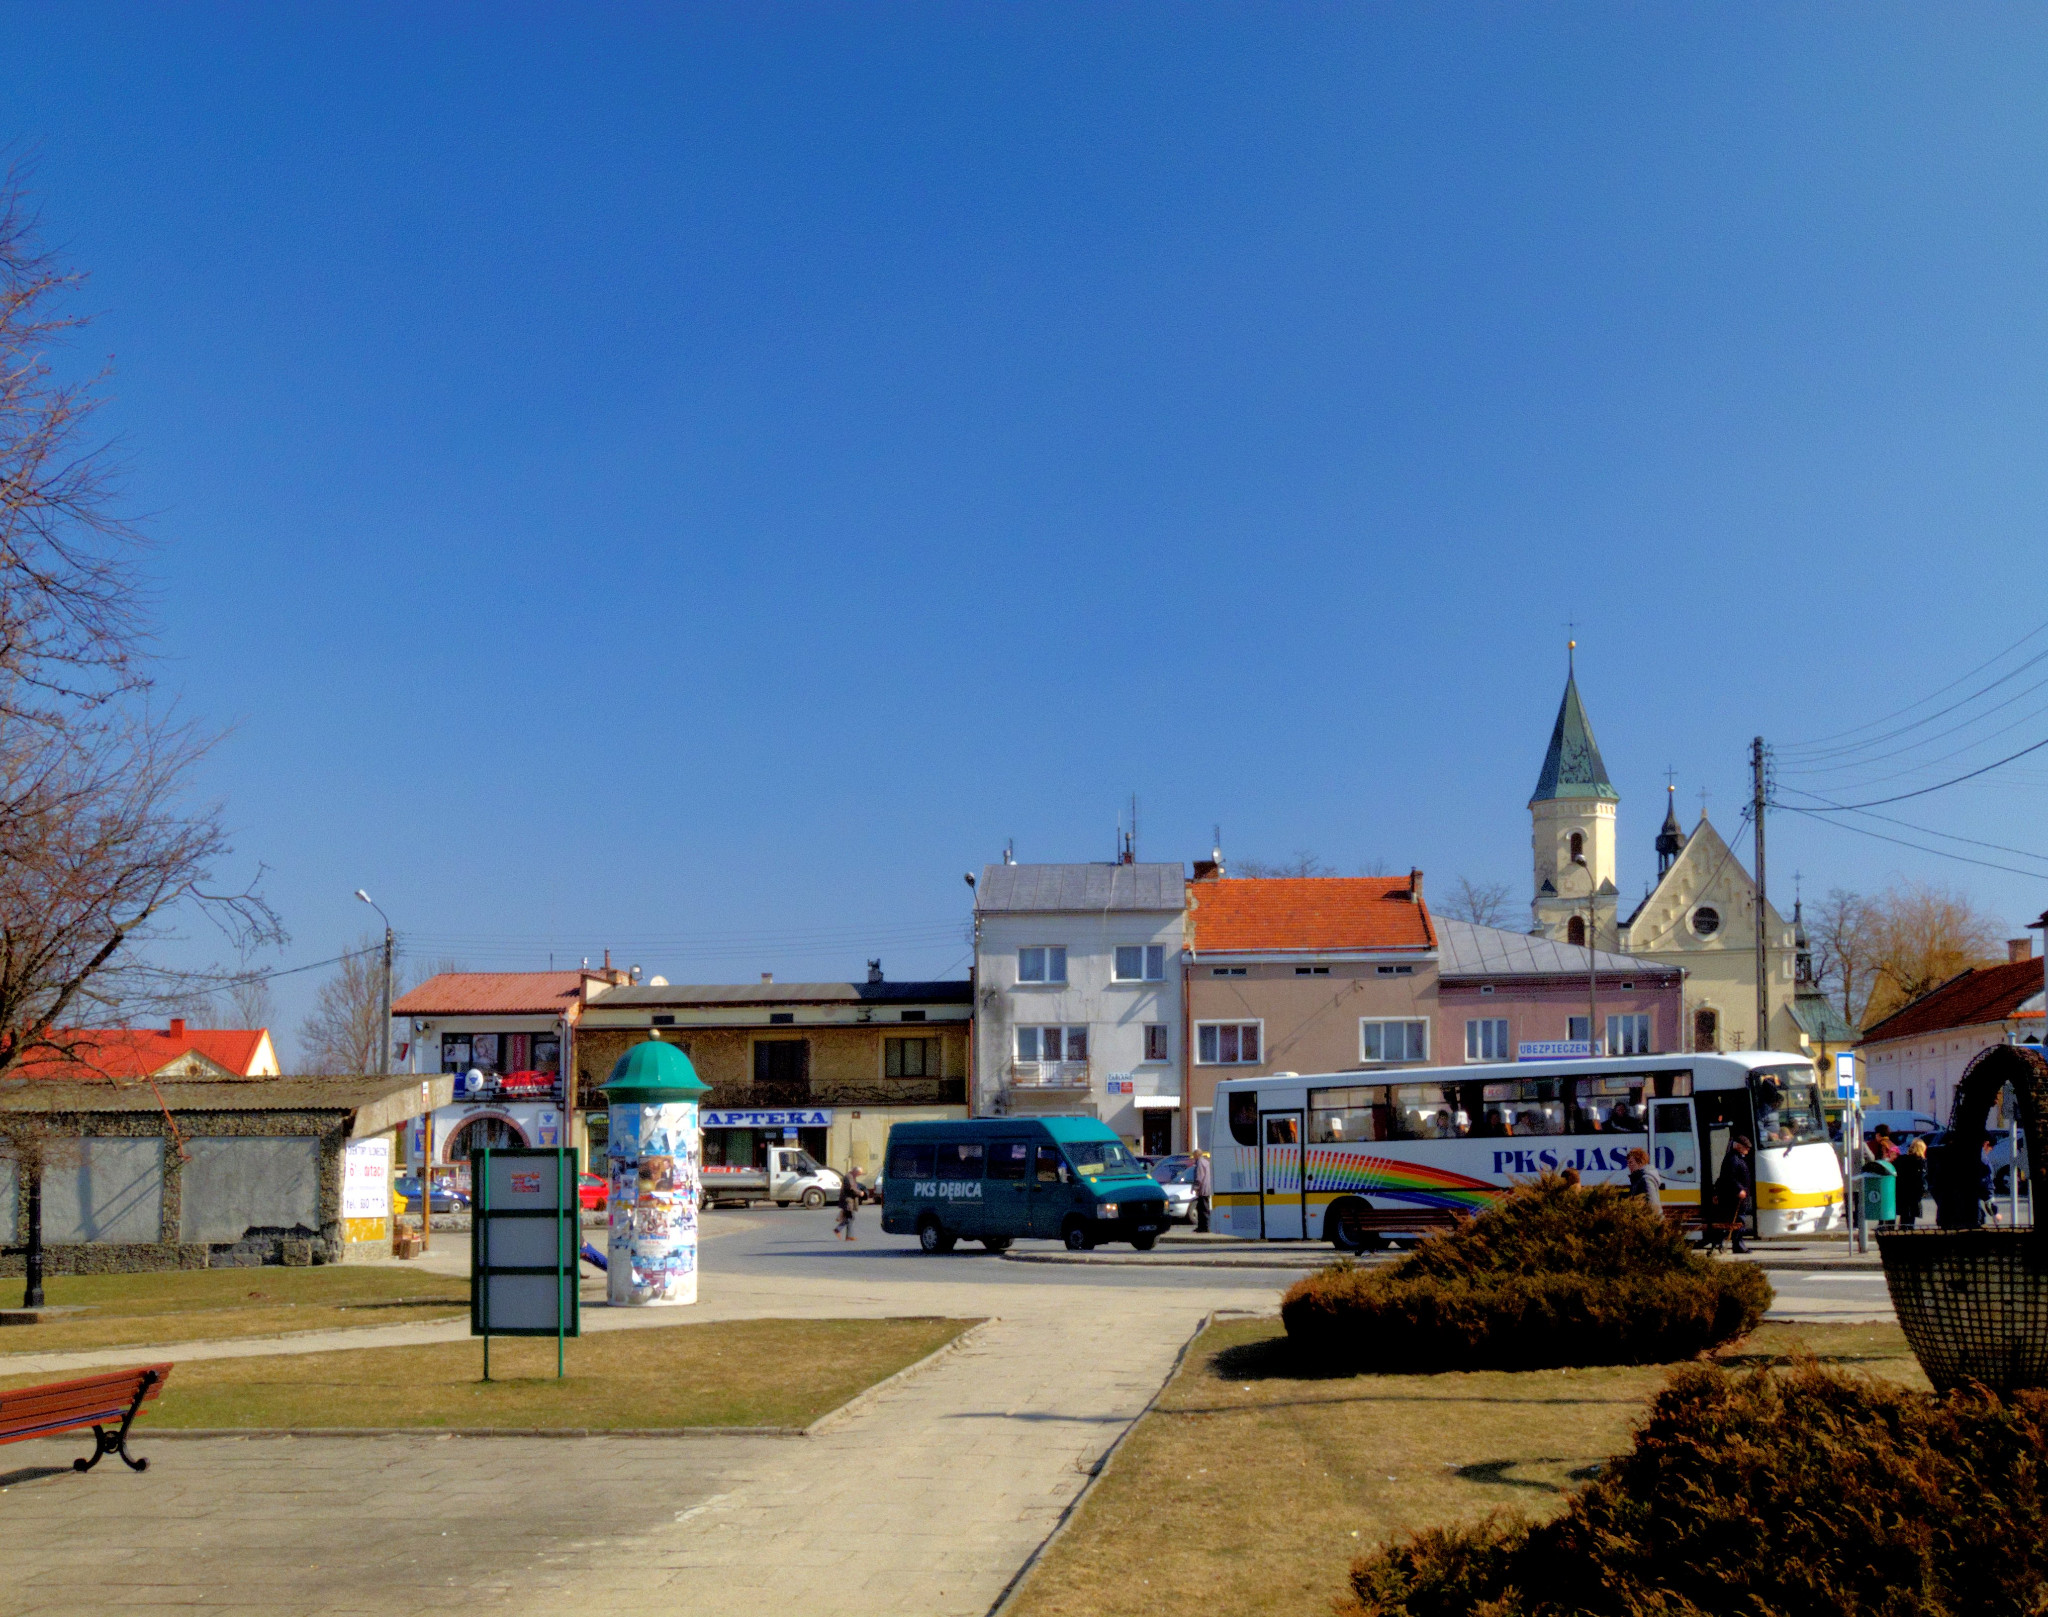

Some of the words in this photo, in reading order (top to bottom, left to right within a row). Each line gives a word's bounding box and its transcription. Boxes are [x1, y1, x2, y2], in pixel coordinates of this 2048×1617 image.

[703, 1111, 828, 1125] APTEKA
[1492, 1148, 1559, 1173] PKS
[1566, 1146, 1675, 1171] JASO
[913, 1181, 937, 1197] PKS
[938, 1181, 982, 1201] DĘBICA
